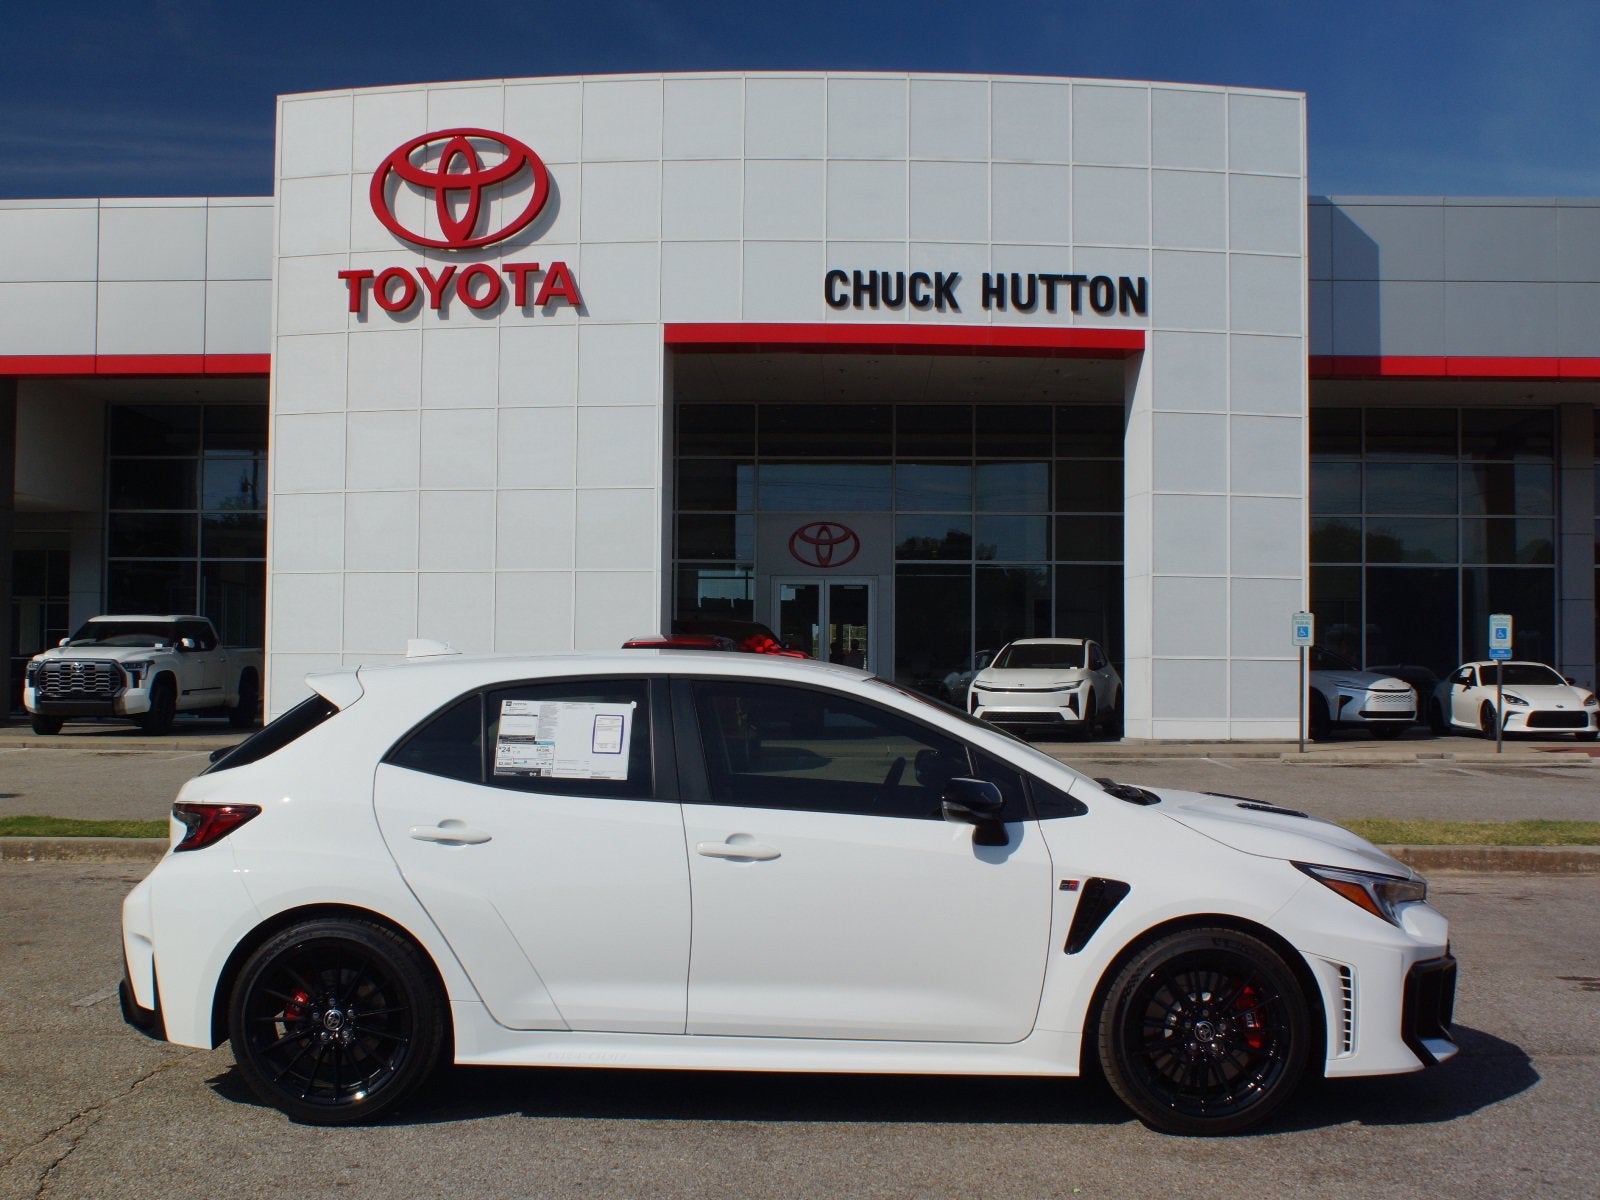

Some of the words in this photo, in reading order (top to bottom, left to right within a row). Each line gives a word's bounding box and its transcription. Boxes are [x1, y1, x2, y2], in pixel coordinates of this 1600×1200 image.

[338, 261, 580, 313] TOYOTA
[824, 269, 959, 310] CHUCK
[981, 272, 1147, 314] HUTTON
